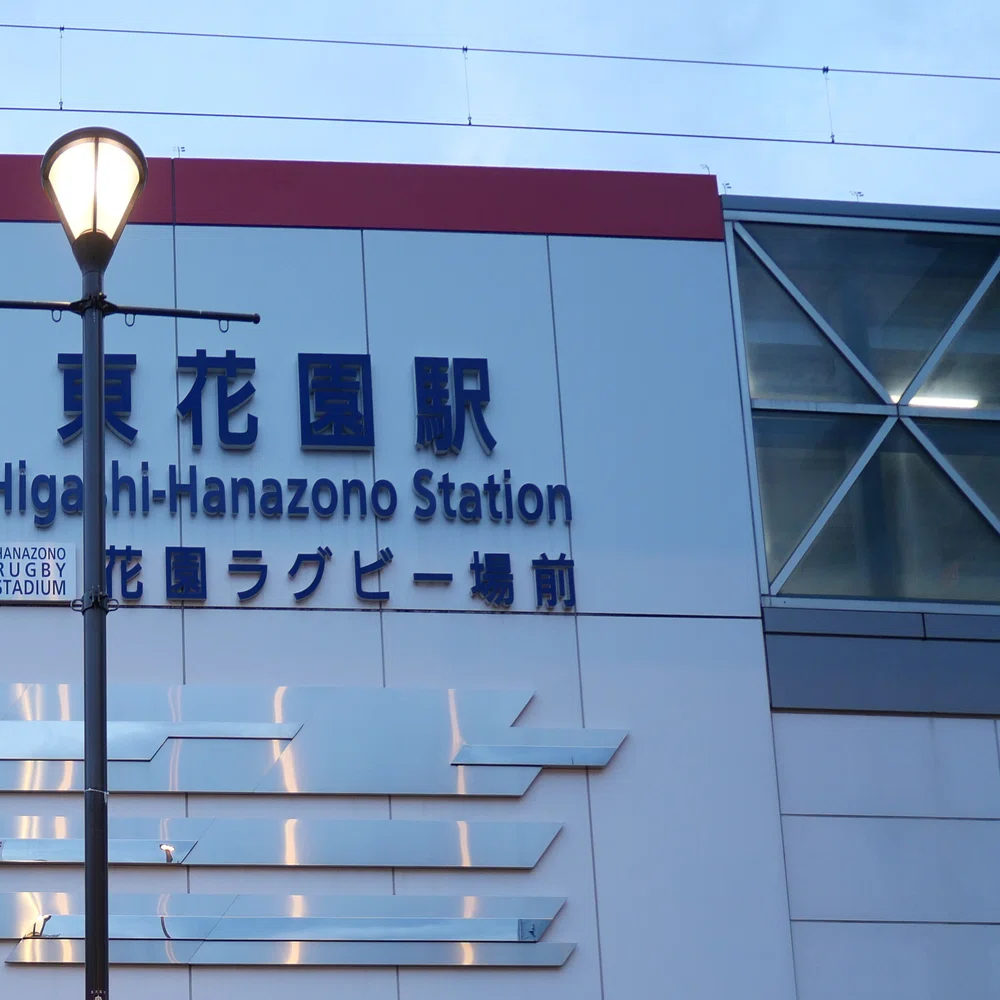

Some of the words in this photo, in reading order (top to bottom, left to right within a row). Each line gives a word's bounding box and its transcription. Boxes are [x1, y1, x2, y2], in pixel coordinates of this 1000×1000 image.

[56, 348, 498, 455] 東花園駅
[412, 468, 573, 523] Station
[105, 544, 576, 610] 花園ラグビー場前
